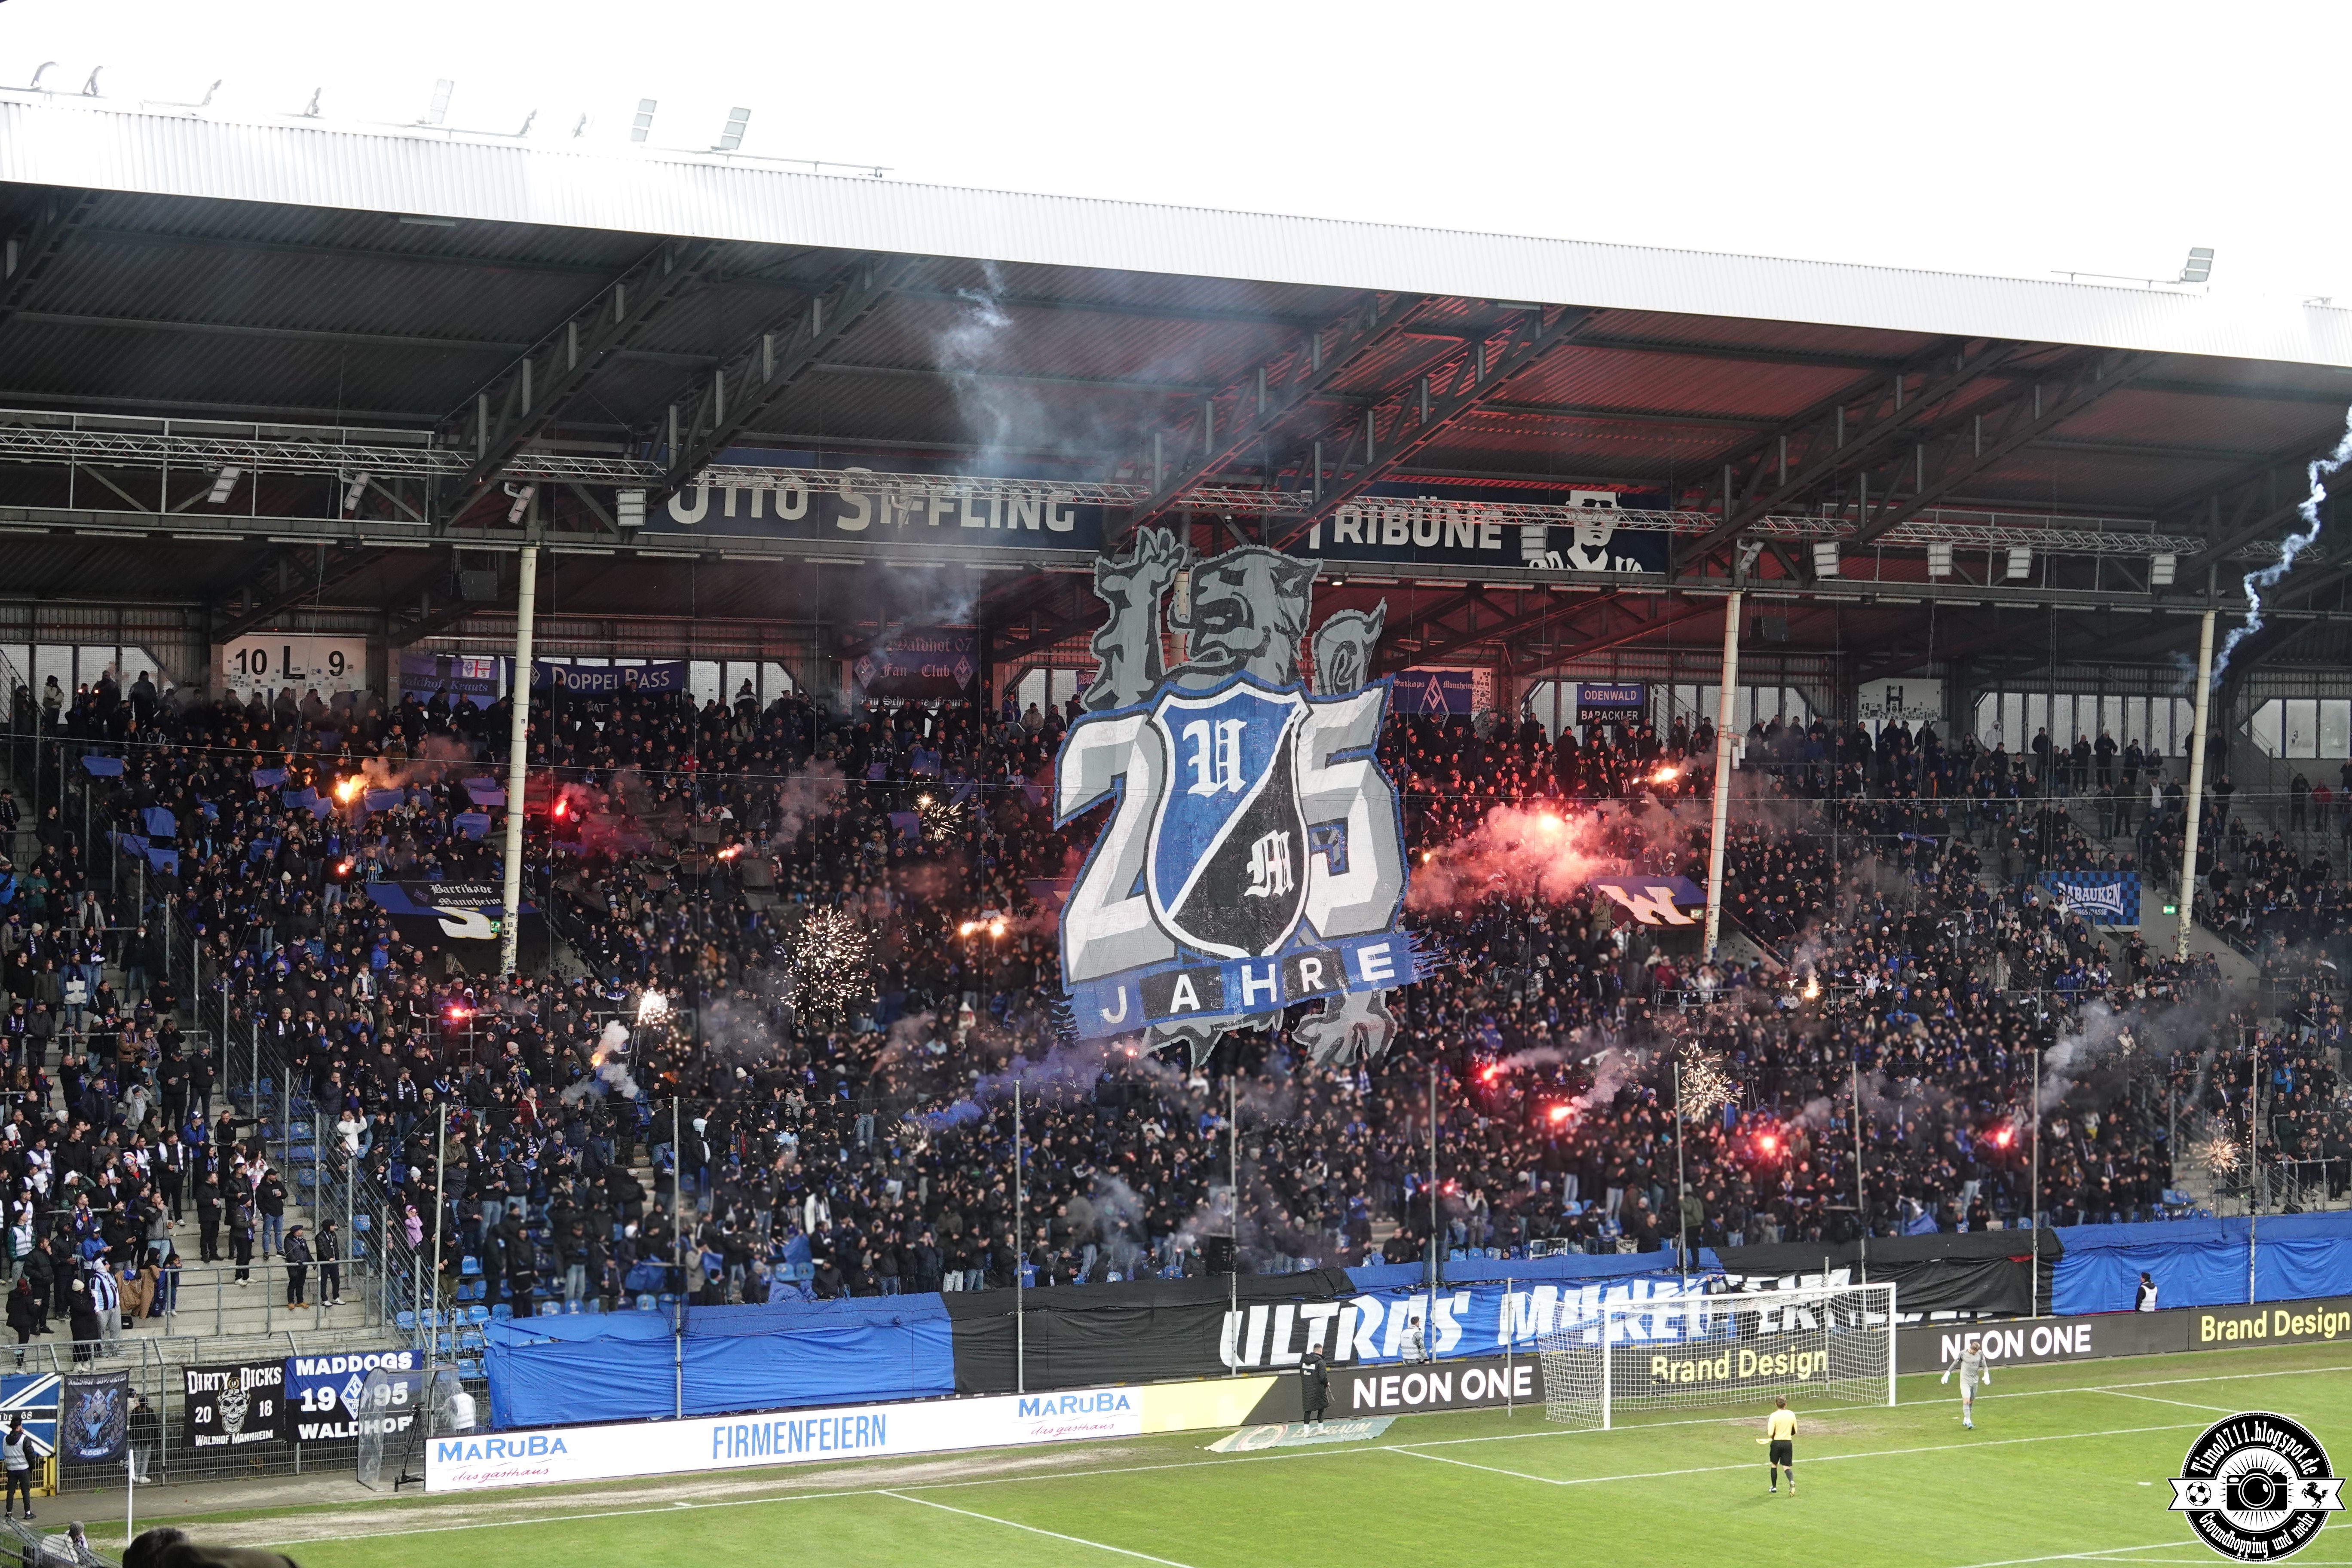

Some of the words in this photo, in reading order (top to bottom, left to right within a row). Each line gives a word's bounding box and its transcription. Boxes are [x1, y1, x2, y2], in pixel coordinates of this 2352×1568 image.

[836, 467, 1074, 532] SIFFLING
[955, 637, 973, 653] 07
[235, 649, 267, 675] 10
[283, 646, 306, 680] L
[328, 650, 345, 677] 9
[880, 663, 907, 678] Fan
[921, 664, 950, 677] Club
[403, 676, 445, 691] aldhof
[450, 680, 489, 692] Krauts
[1584, 690, 1637, 701] ODENWALD
[1886, 685, 1903, 713] H
[1581, 710, 1639, 721] BARACKLER
[429, 883, 493, 895] Barrikade
[438, 897, 502, 907] Mannheim
[1100, 942, 1395, 1023] JAHRE
[1219, 1291, 1472, 1367] ULTRAS
[2201, 1311, 2267, 1342] Brand
[2274, 1307, 2351, 1338] Design
[1941, 1329, 2023, 1363] NEON
[2030, 1324, 2092, 1356] ONE
[296, 1351, 413, 1376] MADDOGS
[1652, 1350, 1730, 1384] Brand
[1738, 1345, 1827, 1380] Design
[187, 1370, 231, 1394] DIRTY
[241, 1367, 282, 1388] DICKS
[1353, 1371, 1452, 1409] NEON
[1461, 1365, 1533, 1401] ONE
[300, 1386, 337, 1412] 19
[373, 1381, 408, 1407] 95
[21, 1411, 33, 1420] 68
[195, 1406, 212, 1423] 20
[259, 1400, 273, 1417] 18
[195, 1434, 229, 1446] WALDHOF
[232, 1430, 273, 1444] MANNHEIM
[298, 1416, 413, 1440] WALDHOF
[713, 1414, 886, 1460] FIRMENFEIERN
[1056, 1422, 1115, 1436] gasthaus
[452, 1470, 478, 1482] das
[478, 1468, 549, 1484] gasthaus
